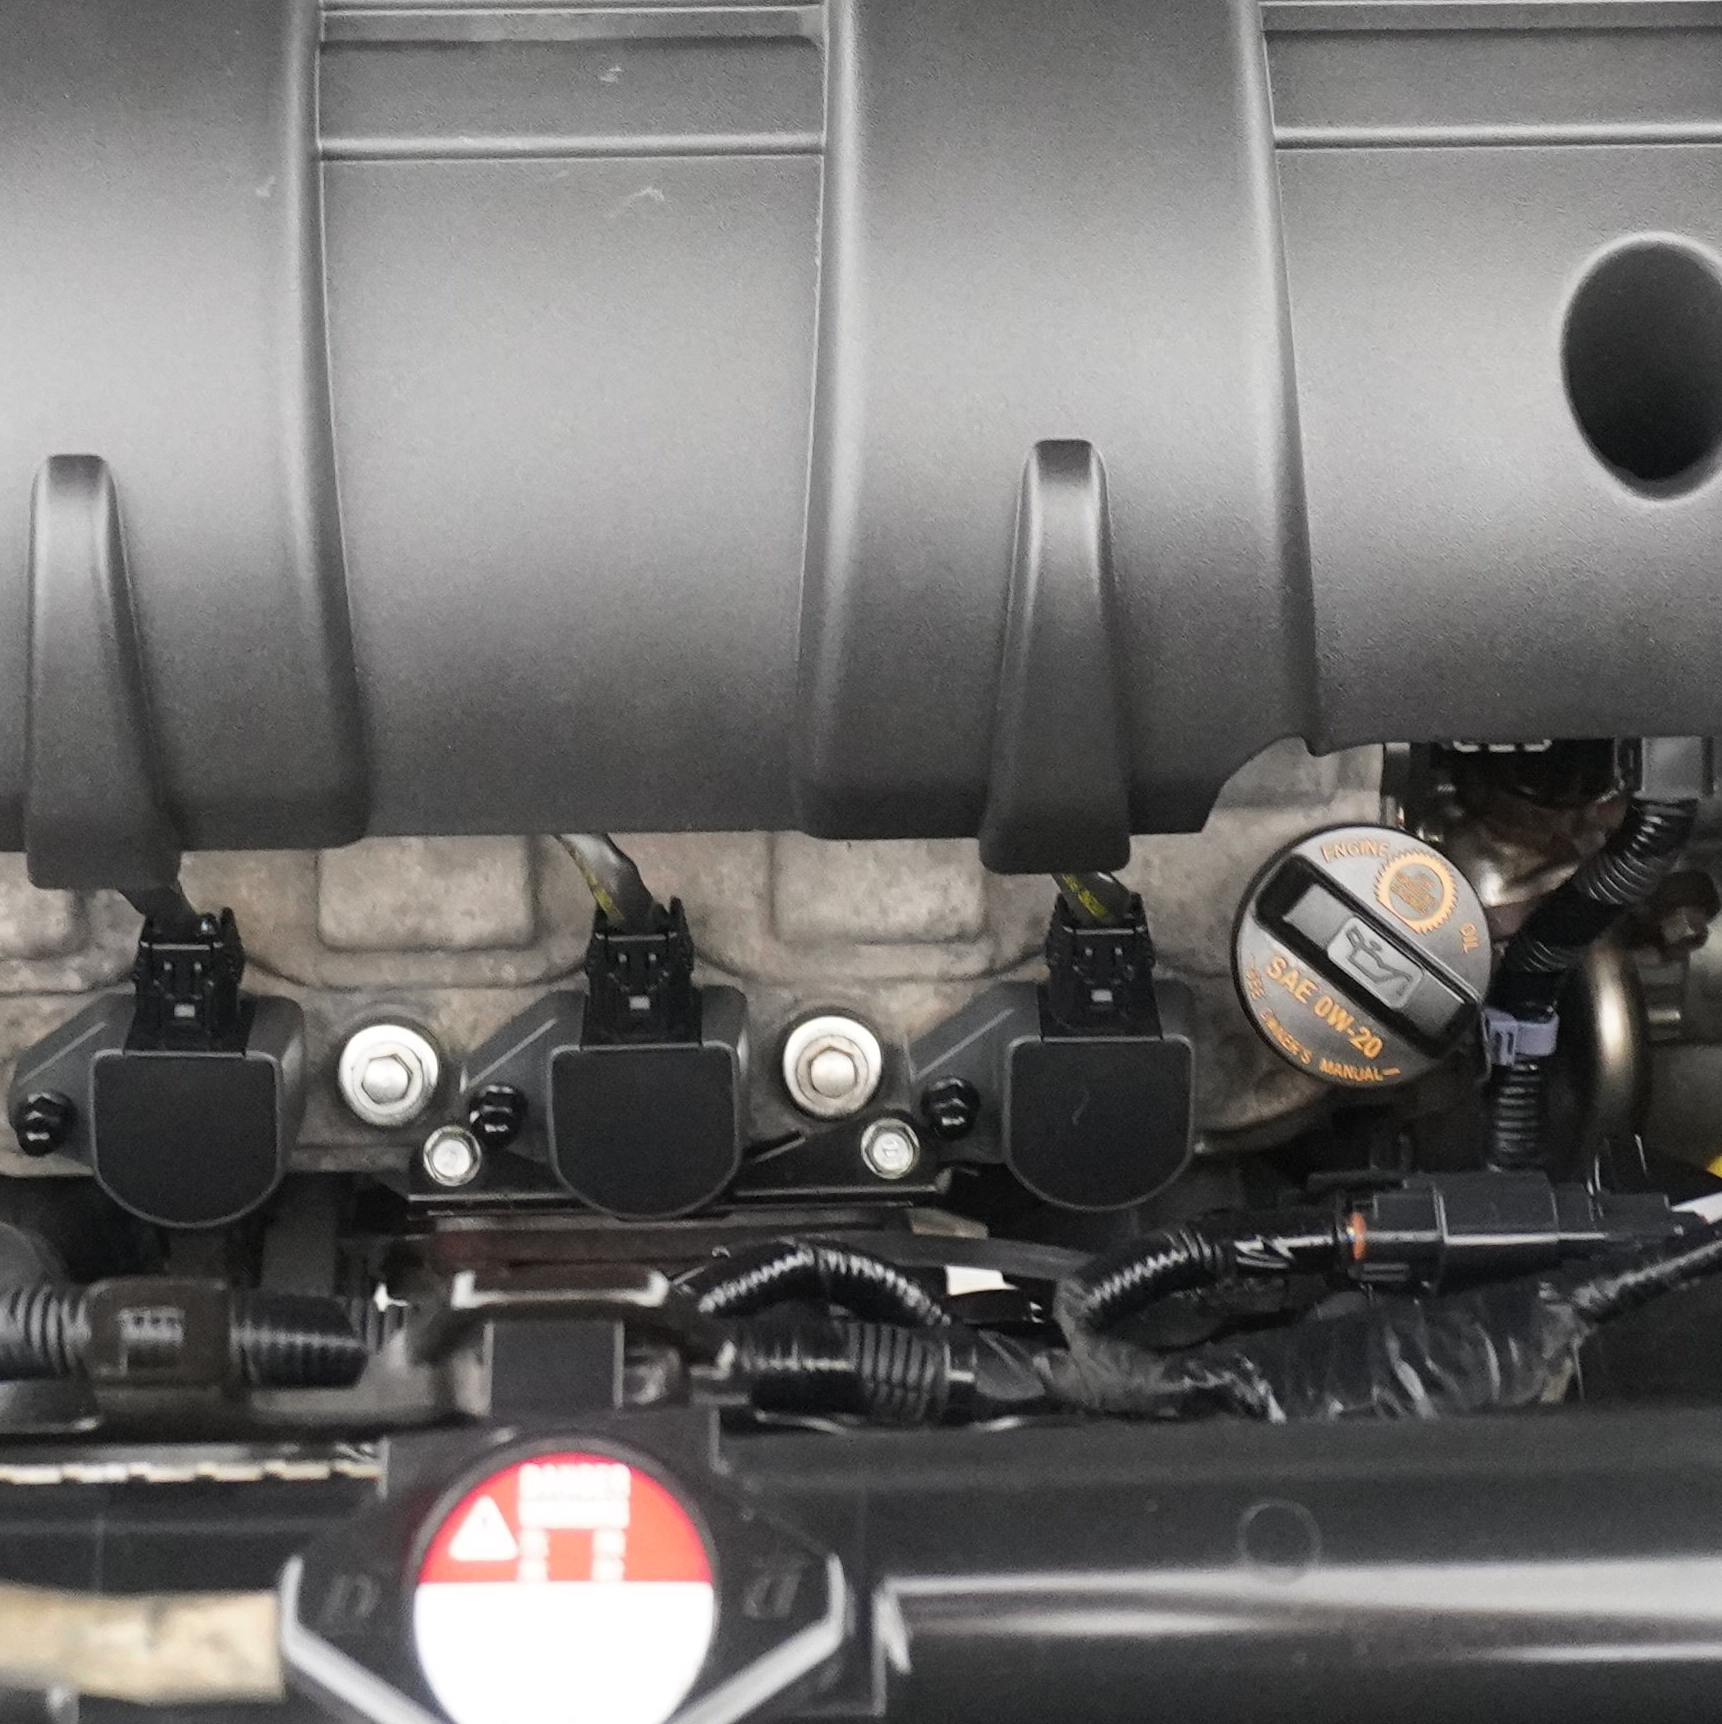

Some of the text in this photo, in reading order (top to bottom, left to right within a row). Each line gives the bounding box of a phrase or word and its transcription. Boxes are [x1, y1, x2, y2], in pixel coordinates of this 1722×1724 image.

[1320, 837, 1391, 864] ENGINE
[1459, 923, 1480, 955] OIL
[1265, 956, 1385, 1060] SAE 0W-20
